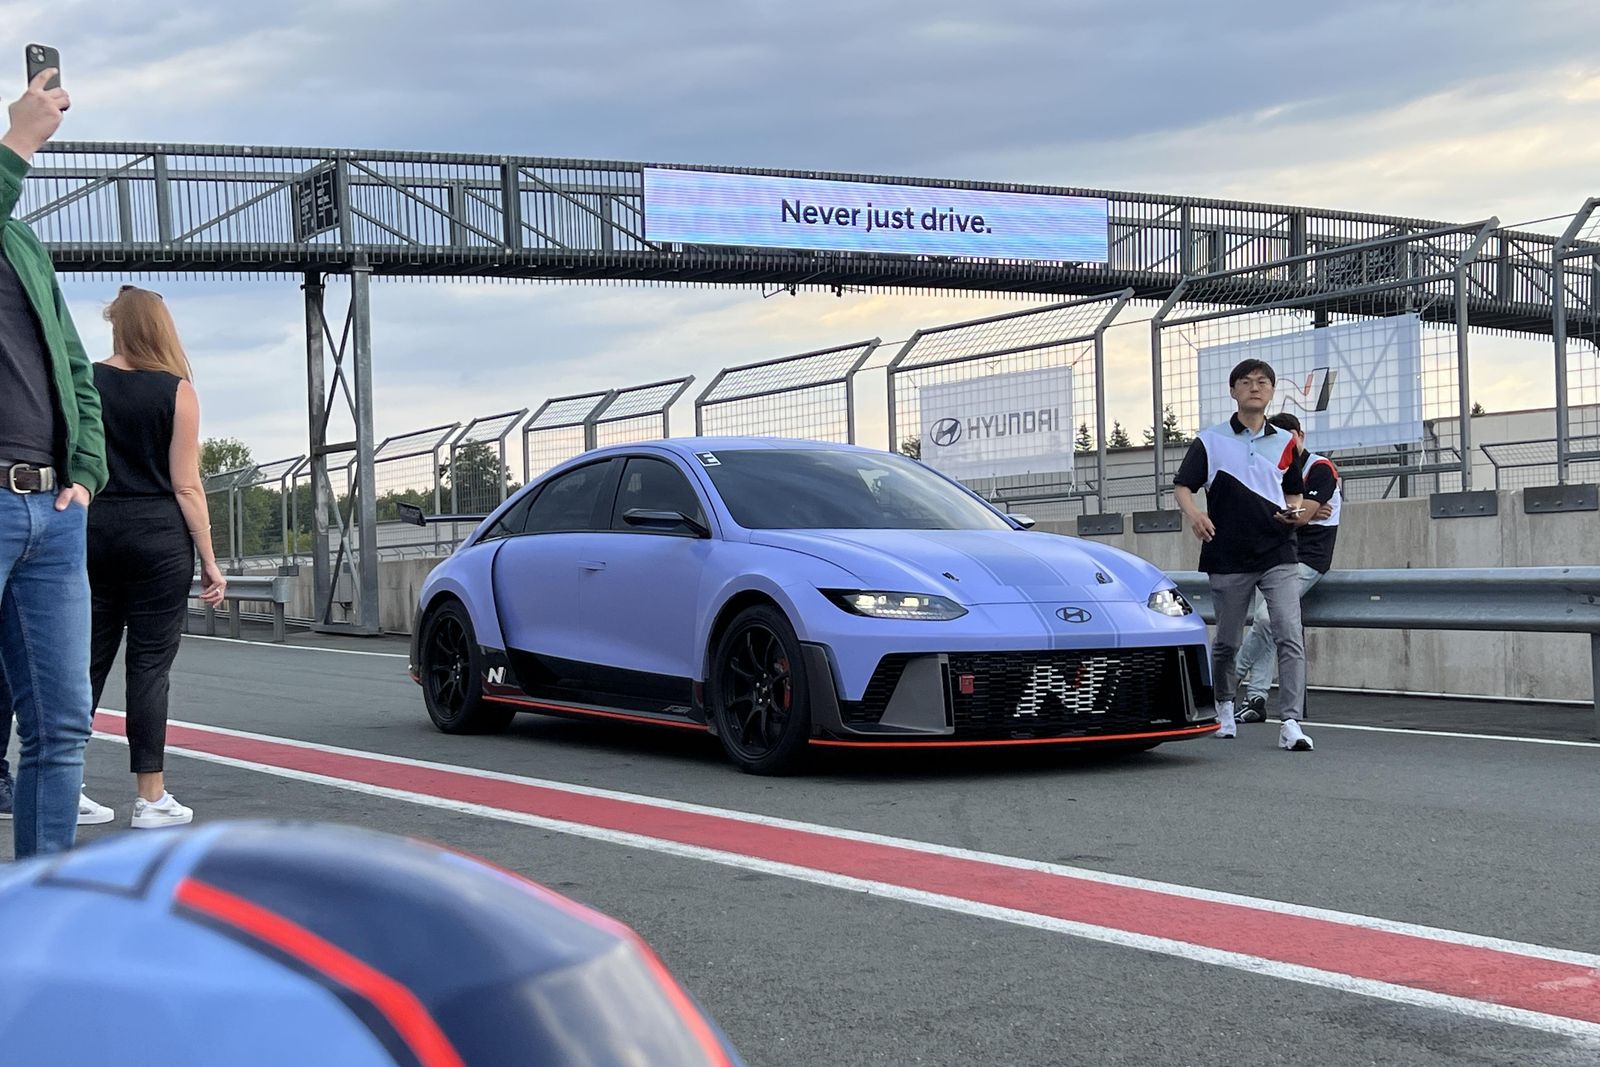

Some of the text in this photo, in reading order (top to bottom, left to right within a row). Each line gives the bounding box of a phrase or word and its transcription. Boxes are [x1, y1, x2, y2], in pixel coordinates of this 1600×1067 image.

[782, 198, 992, 234] Never just drive.
[966, 407, 1059, 440] HYUNDAI
[487, 666, 505, 684] N
[1013, 657, 1120, 717] N
